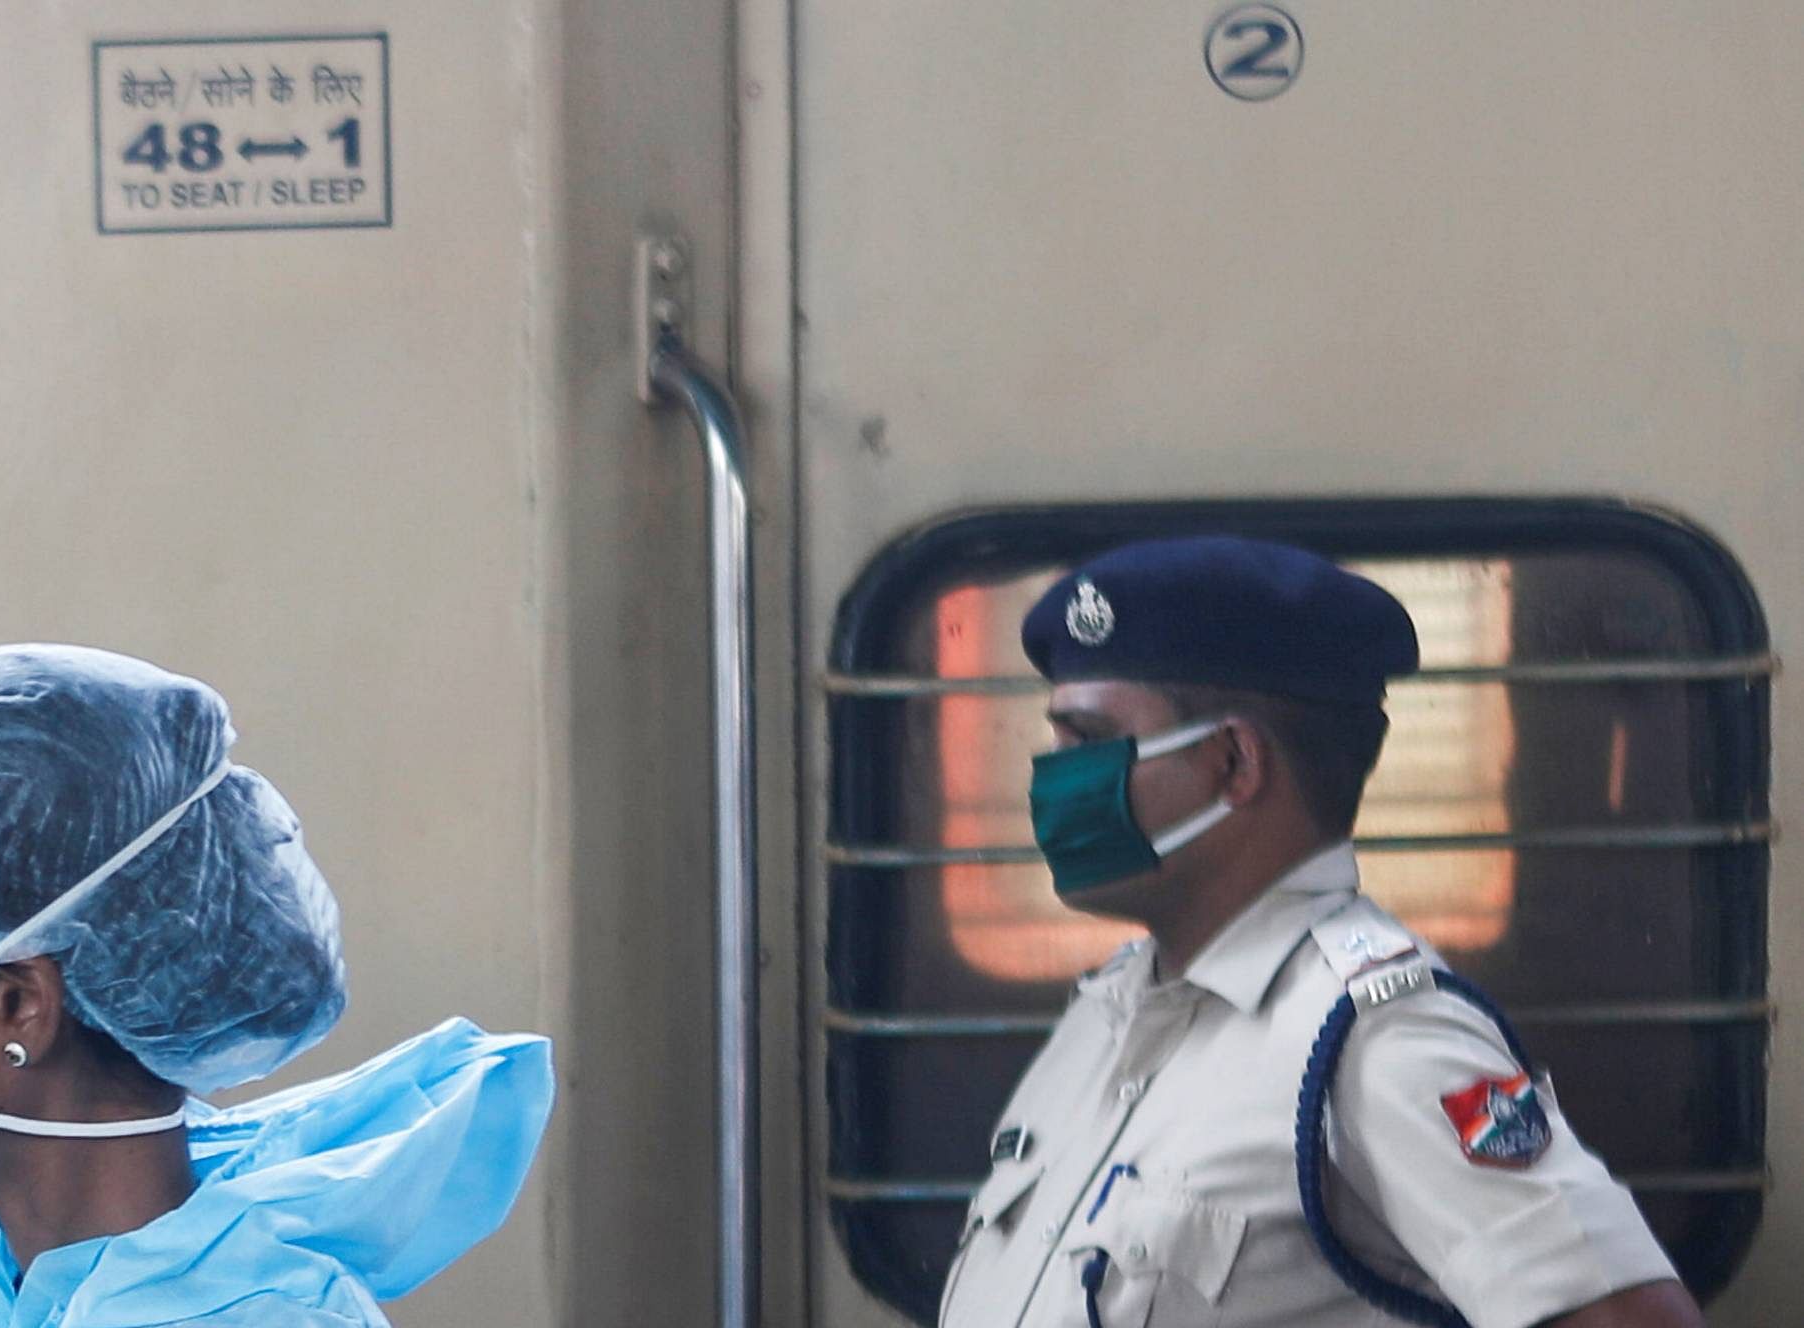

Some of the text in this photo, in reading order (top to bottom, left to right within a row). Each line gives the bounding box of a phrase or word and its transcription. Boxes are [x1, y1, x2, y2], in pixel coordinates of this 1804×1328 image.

[1222, 20, 1289, 77] 2
[267, 64, 296, 104] के
[310, 63, 363, 106] लिए
[122, 117, 361, 173] 48 1
[121, 183, 161, 209] TO
[170, 181, 244, 209] SEAT
[271, 178, 367, 206] SLEEP
